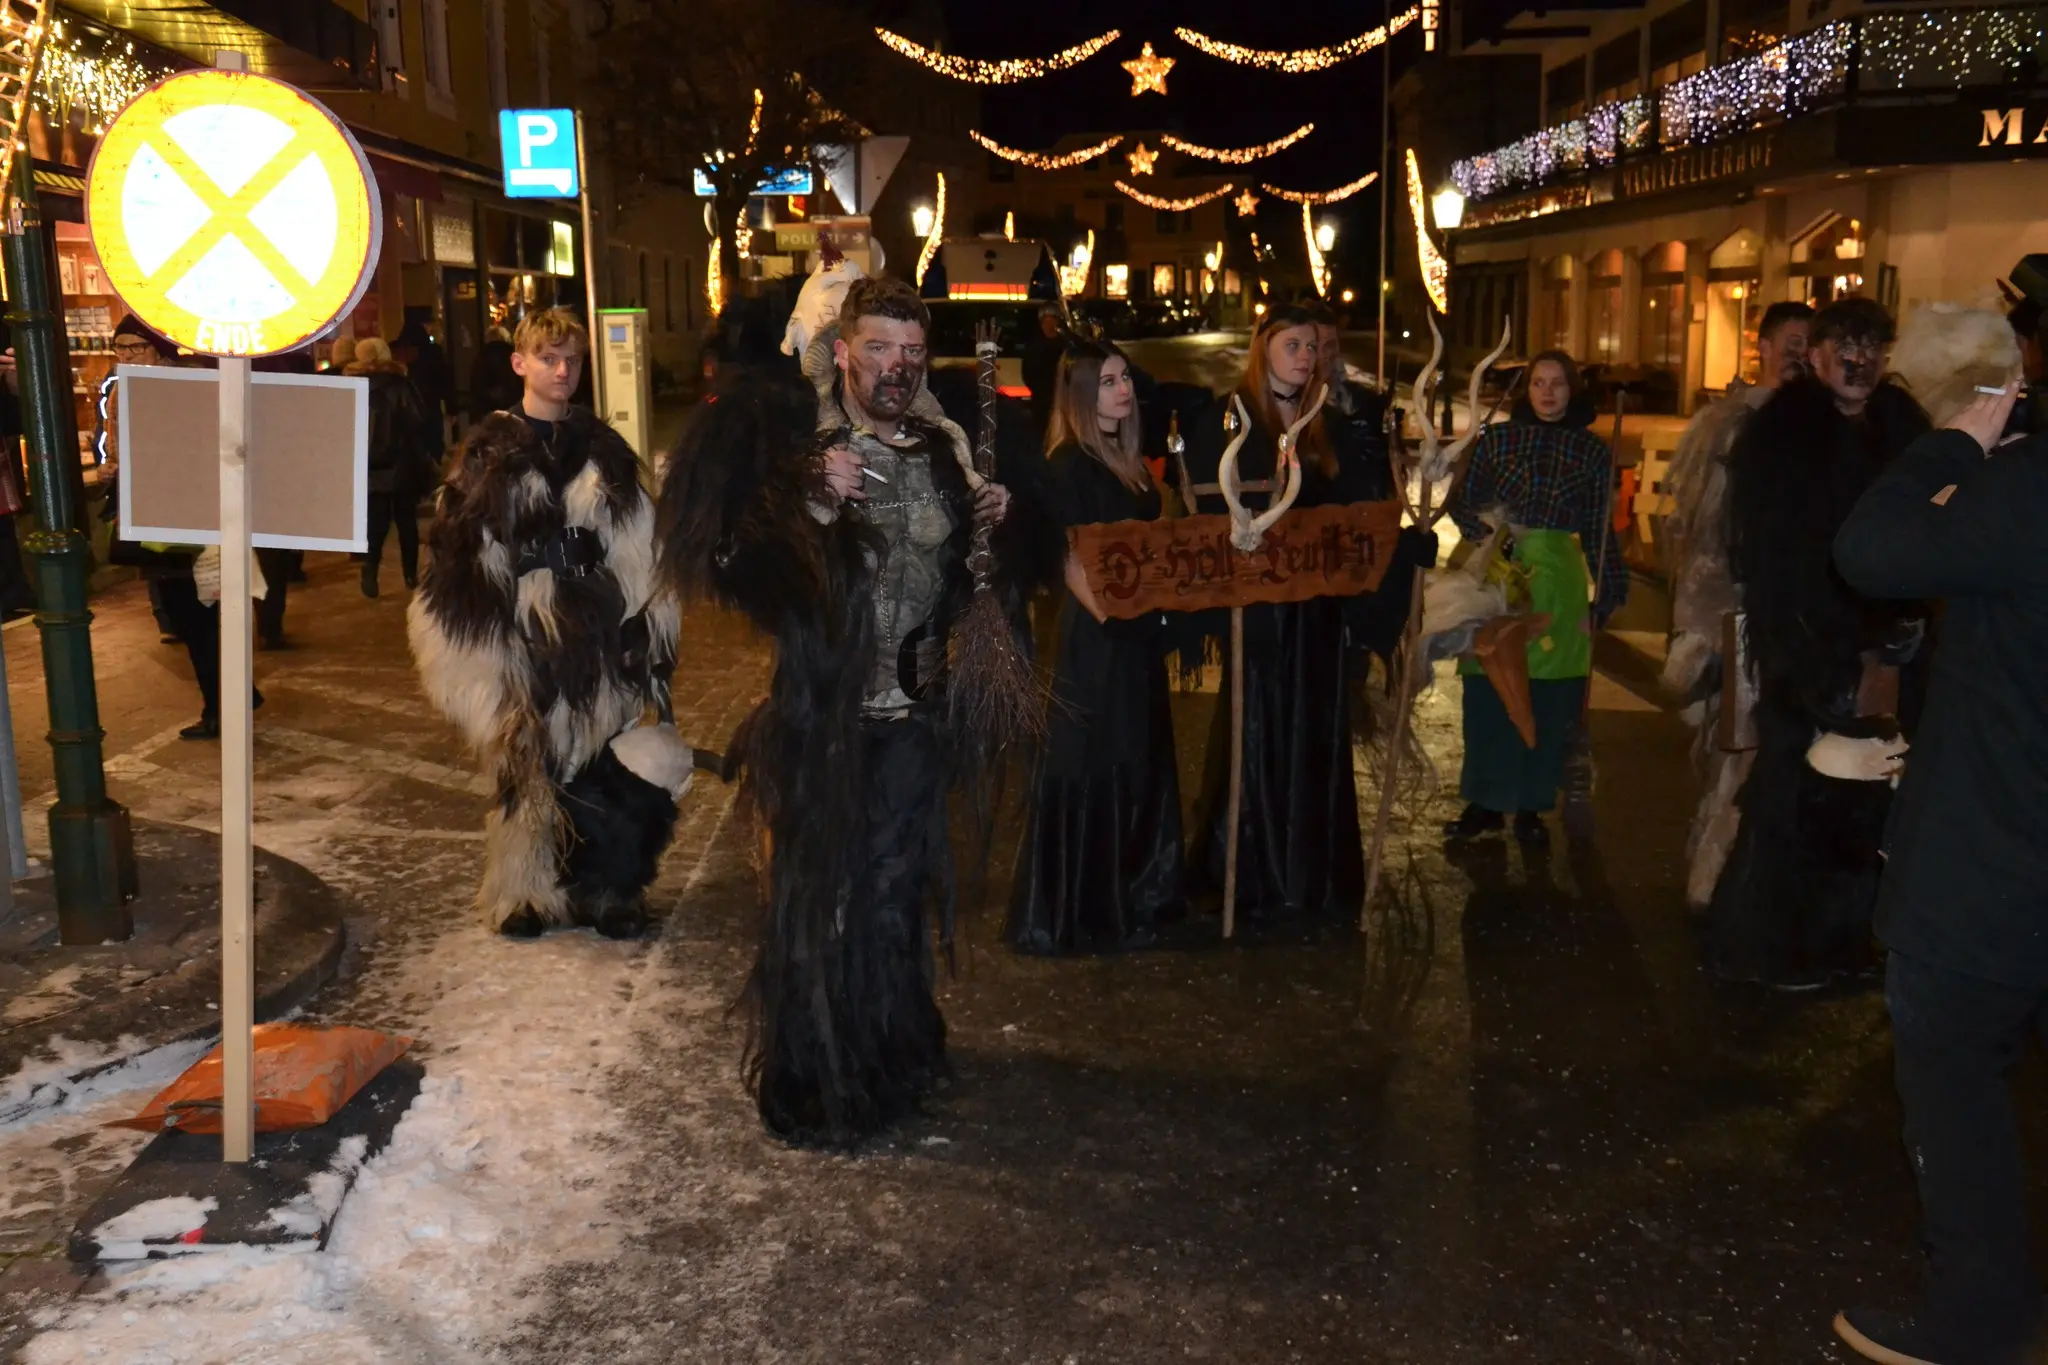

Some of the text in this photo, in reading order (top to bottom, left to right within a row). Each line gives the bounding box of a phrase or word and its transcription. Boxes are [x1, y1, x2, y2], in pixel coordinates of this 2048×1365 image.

[517, 114, 558, 168] P
[780, 231, 840, 246] POLIEI
[195, 320, 267, 354] ENDE
